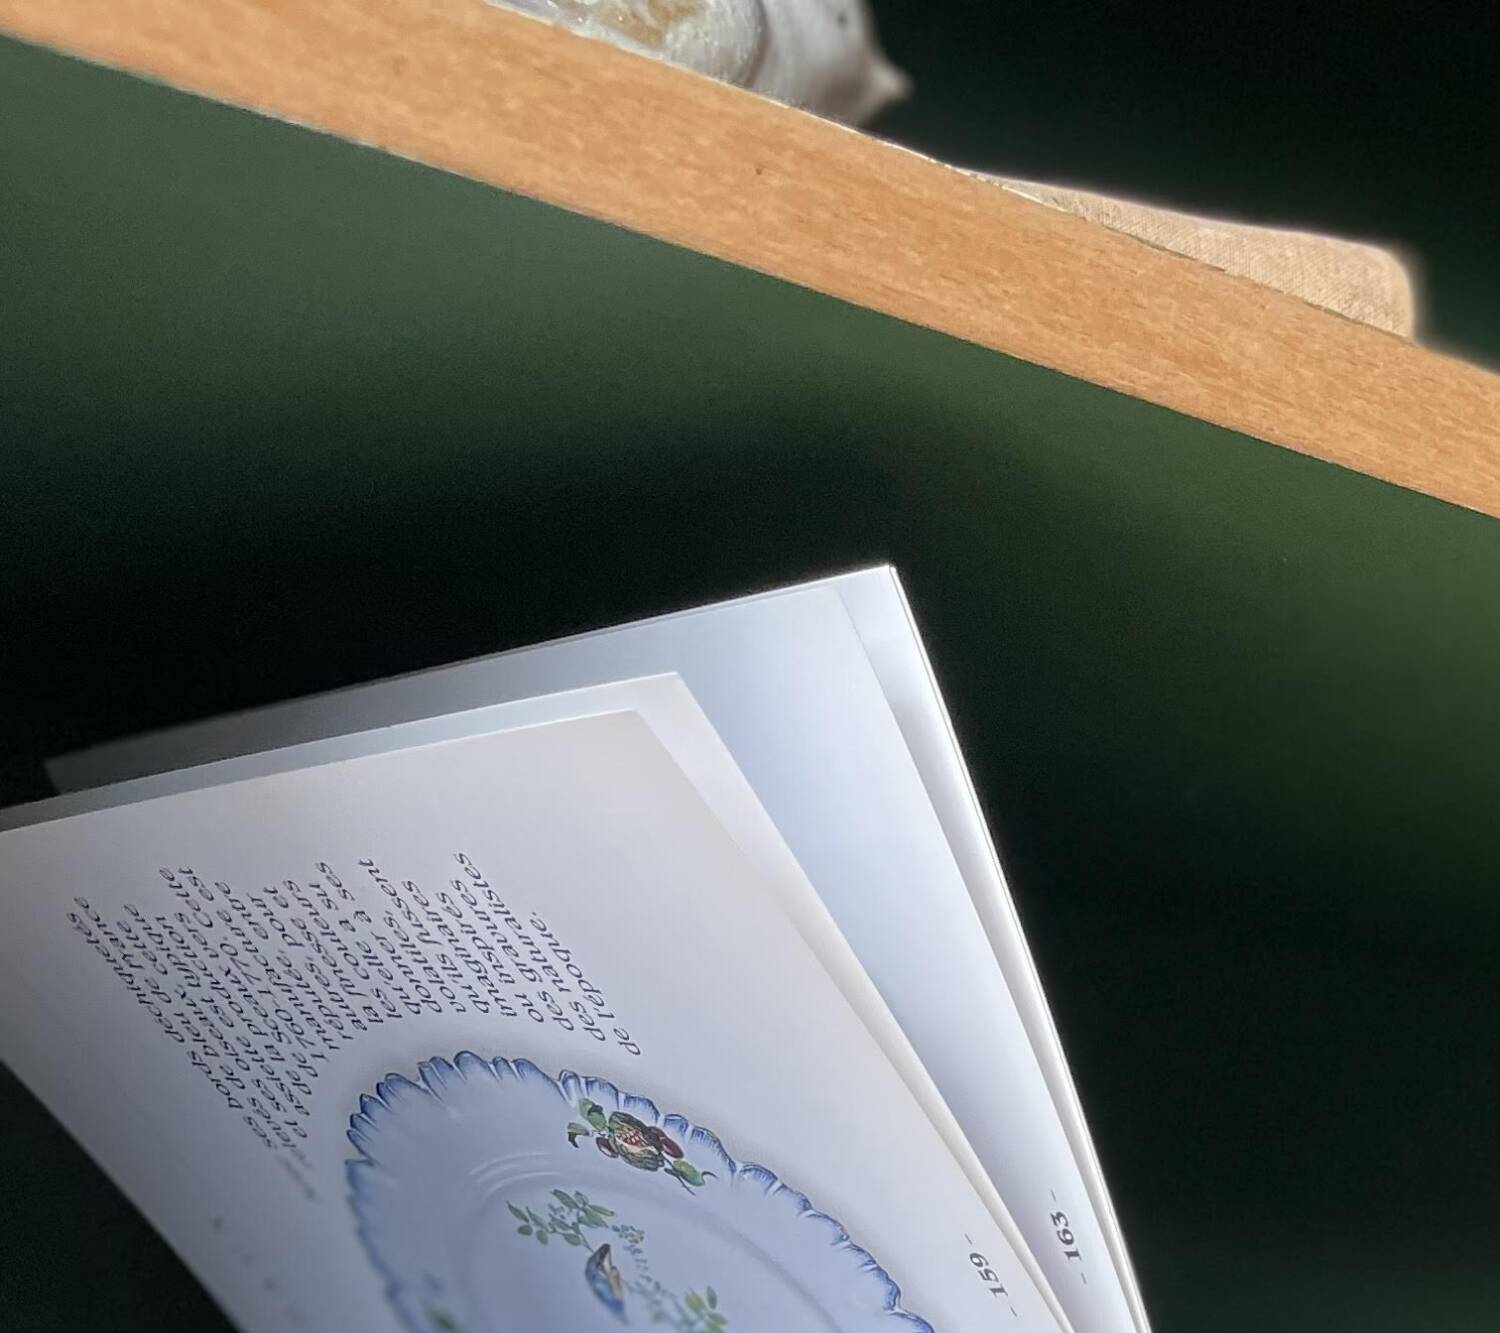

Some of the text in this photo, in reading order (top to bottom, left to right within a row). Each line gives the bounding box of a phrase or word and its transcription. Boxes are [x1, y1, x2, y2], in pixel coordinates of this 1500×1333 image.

[74, 898, 144, 969] France
[117, 922, 168, 975] cette
[124, 907, 202, 986] typique
[159, 869, 213, 926] Cette
[179, 869, 340, 1050] manufacture est
[264, 888, 384, 1023] la finesse et
[283, 880, 403, 1018] les couleurs
[309, 884, 422, 1013] qu'elle a su
[317, 862, 442, 1013] donner à ses
[358, 859, 490, 1011] qu'ils fussent
[402, 881, 517, 1016] imaginaires
[436, 892, 544, 1021] ou inspirés
[451, 880, 574, 1030] des gravures
[456, 853, 606, 1041] des naturalistes
[144, 979, 172, 1003] de
[155, 916, 312, 1094] de la production
[174, 912, 318, 1077] de Sceaux vers
[200, 997, 235, 1028] est
[214, 882, 353, 1040] réputée, entre
[220, 937, 326, 1059] 1760-1770.
[248, 895, 368, 1031] autres, pour
[383, 911, 466, 1012] volatiles,
[530, 912, 641, 1055] de l'époque.
[70, 913, 277, 1149] ses bords déchiquetés
[173, 1012, 220, 1057] bleu
[174, 985, 251, 1071] oiseaux,
[219, 1066, 246, 1089] de
[236, 1037, 310, 1115] assiette
[251, 1079, 287, 1112] ses
[284, 1120, 307, 1138] et
[969, 1252, 1008, 1297] 159
[1051, 1211, 1082, 1261] 163
